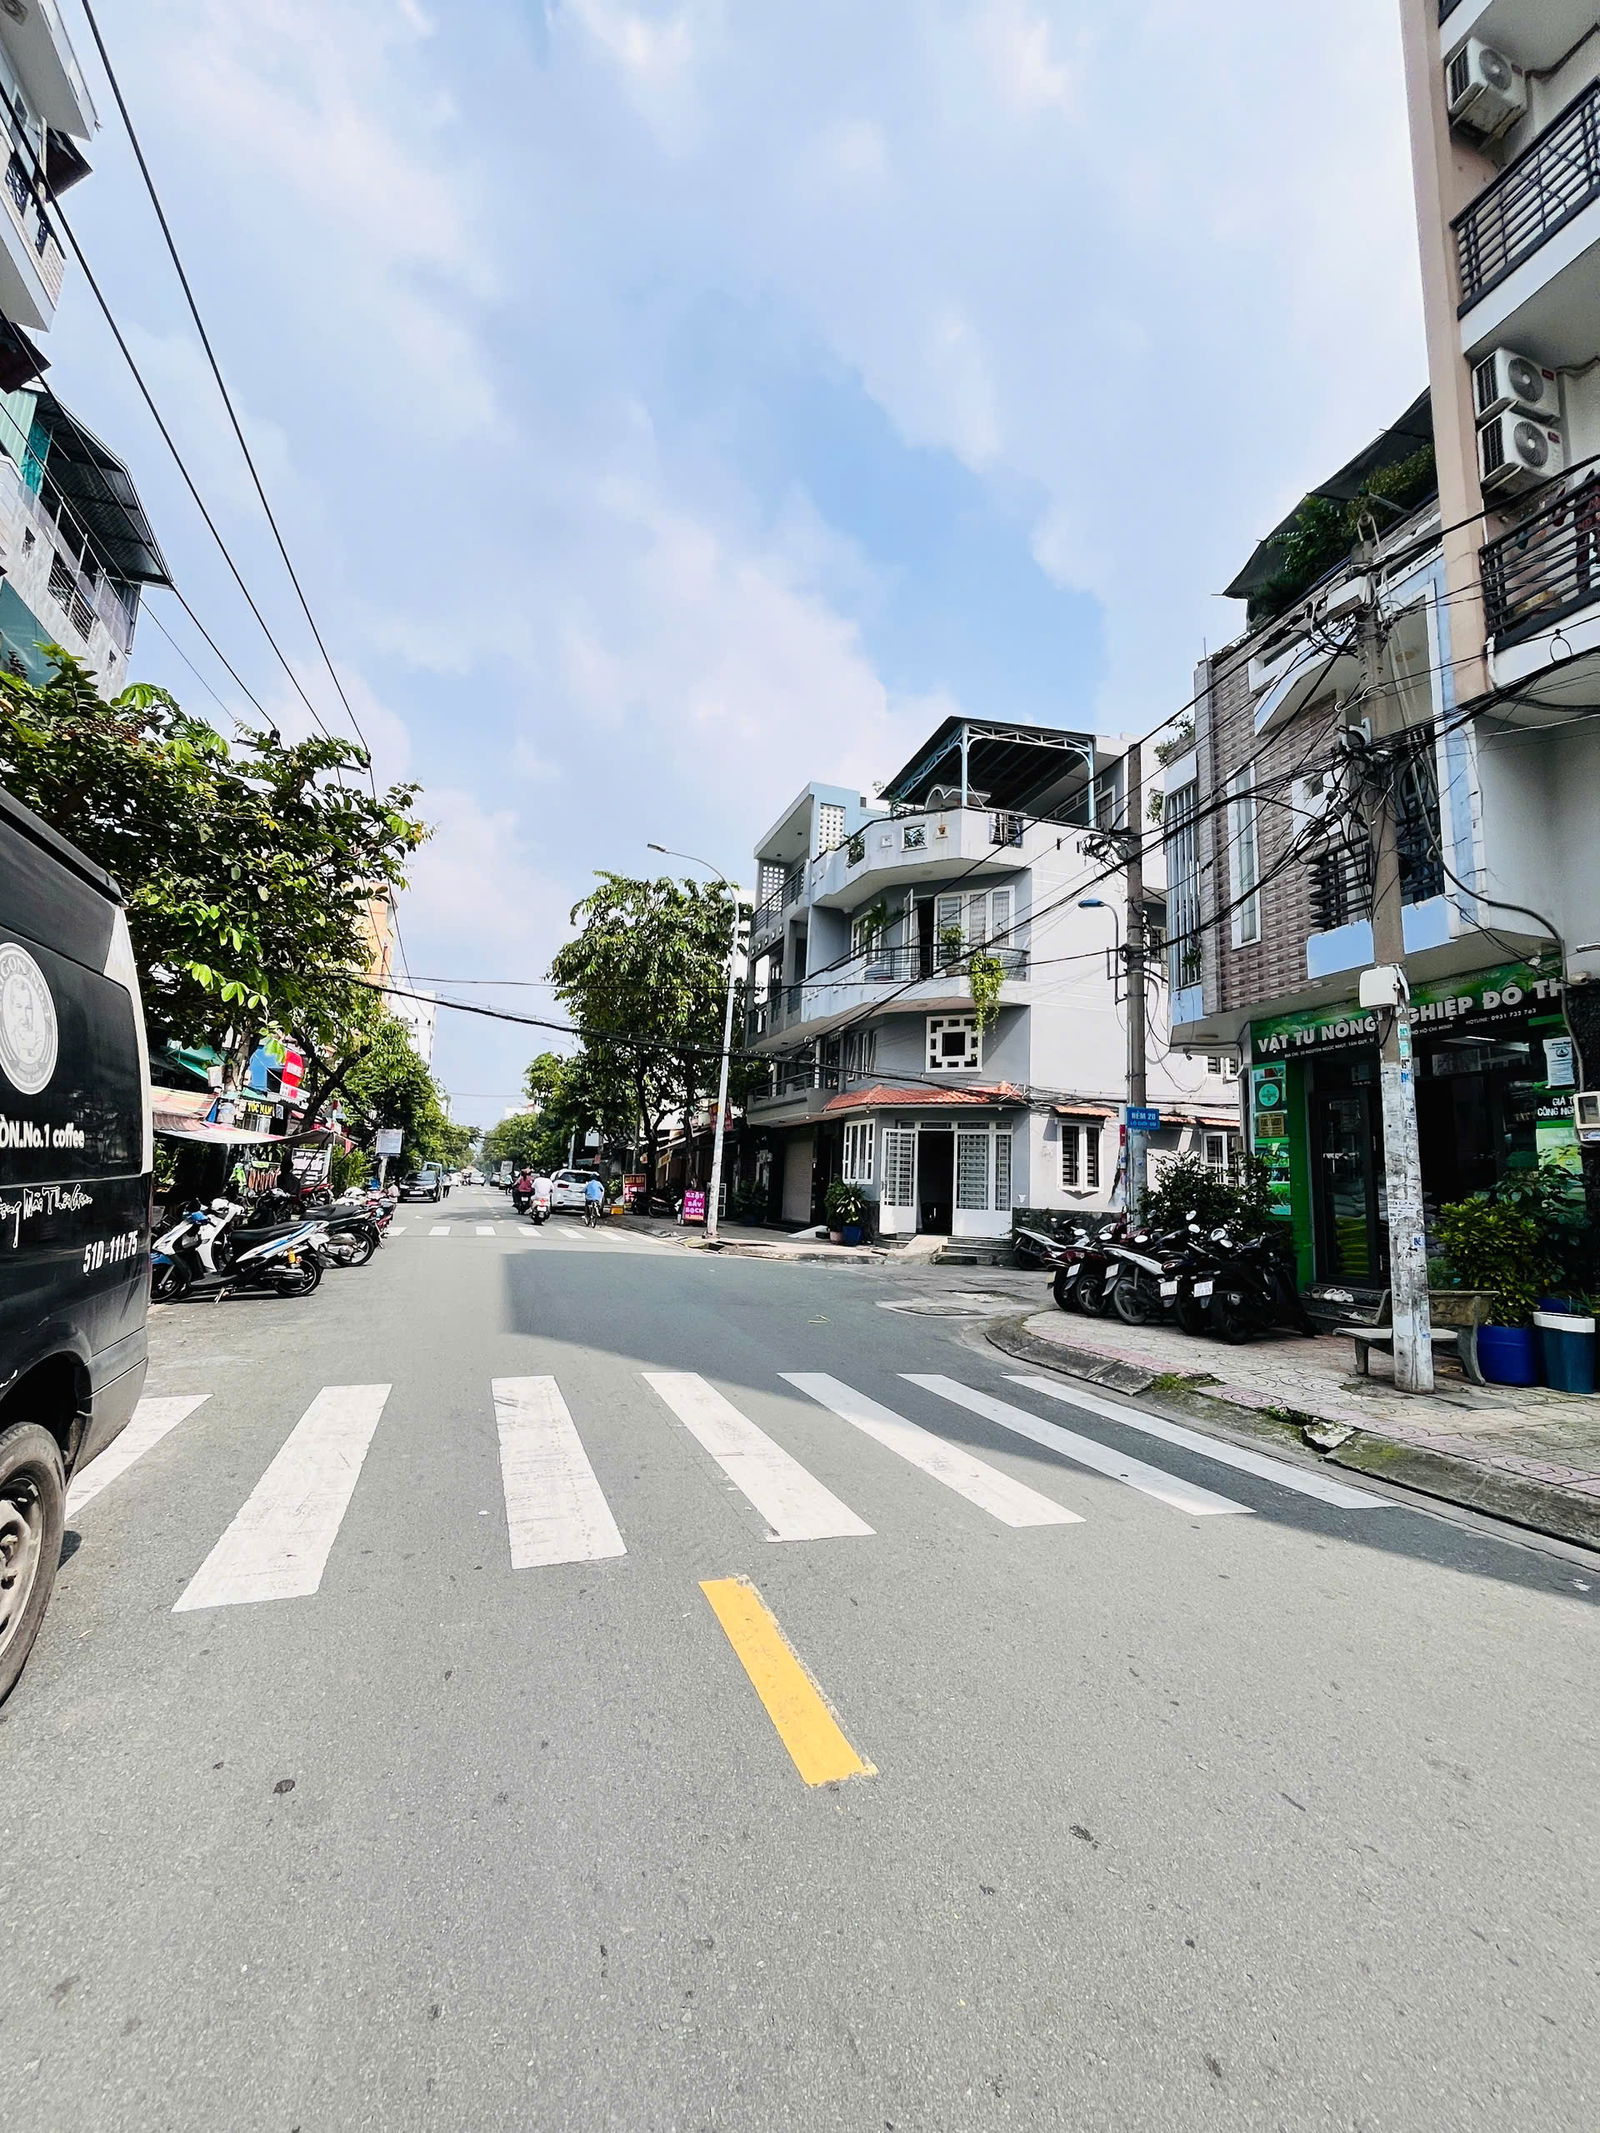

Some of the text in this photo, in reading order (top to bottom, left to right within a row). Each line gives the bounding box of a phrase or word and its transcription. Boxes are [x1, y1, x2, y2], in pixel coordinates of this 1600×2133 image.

[1258, 1033, 1288, 1053] VẬT
[1321, 1016, 1377, 1041] NÔNG
[1408, 994, 1474, 1025] GHIỆP
[1482, 983, 1523, 1010] ĐÔ
[1532, 977, 1565, 1000] TH
[53, 1122, 85, 1149] coffee
[83, 1230, 138, 1273] 51D-111.75
